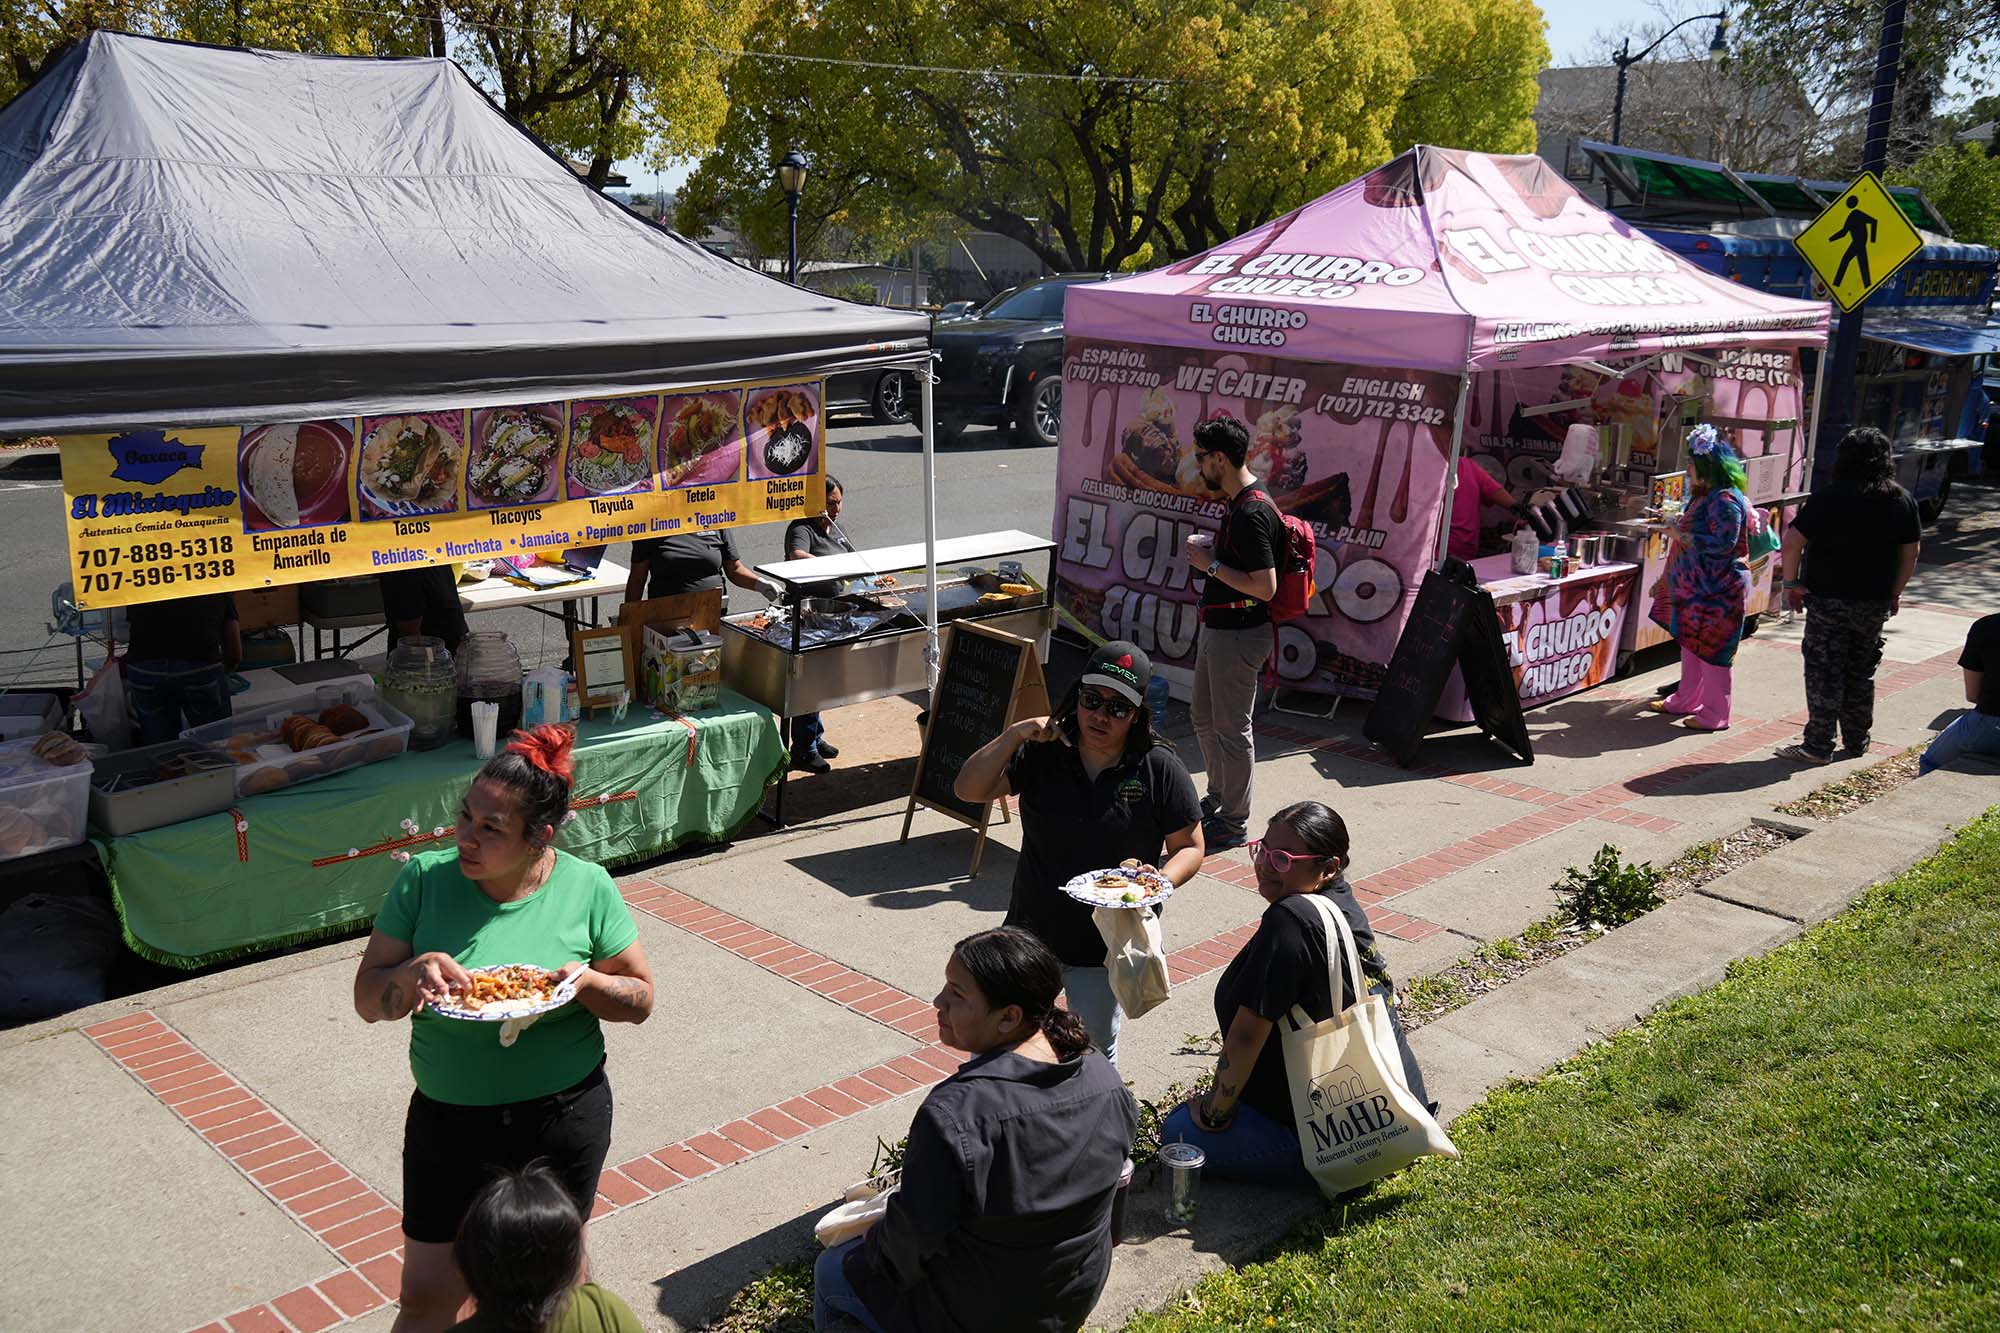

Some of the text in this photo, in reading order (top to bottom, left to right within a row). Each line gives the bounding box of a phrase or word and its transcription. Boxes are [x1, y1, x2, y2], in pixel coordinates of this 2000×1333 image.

[1443, 227, 1530, 273] EL
[1187, 254, 1426, 286] EL CHURRO
[1208, 277, 1358, 299] CHUECO
[1190, 304, 1308, 329] EL CHURRO
[1213, 325, 1286, 347] CHUECO
[1067, 363, 1100, 384] (707)
[1175, 365, 1307, 404] WE CATER
[1341, 377, 1426, 401] ENGLISH
[1316, 394, 1445, 425] (707) 712 3342
[125, 447, 189, 466] Oaxaca
[685, 487, 716, 504] Tetela
[766, 479, 804, 493] Chicken
[1081, 478, 1128, 502] RELLENOS
[1132, 489, 1196, 514] CHOCOLATE
[71, 485, 236, 520] El Mixtequito
[589, 497, 634, 516] Tlayuda
[766, 494, 805, 511] Nuggets
[79, 515, 230, 539] Autentica Comida Oaxaqueña
[393, 520, 431, 537] Tacos
[488, 507, 542, 526] Tlacoyos
[252, 528, 347, 553] Empanada de
[372, 509, 737, 567] Bebidas: Horchata Jamaica Pepino con Limon Tepache
[1061, 497, 1112, 569] EL
[1336, 526, 1387, 550] PLAIN
[78, 535, 234, 570] 707-889-5318
[273, 548, 331, 571] Amarillo
[80, 559, 235, 594] 707-596-1338
[1526, 607, 1617, 663] CHURRO
[1101, 662, 1139, 685] PEMEX
[1518, 653, 1594, 700] CHUECO
[1307, 1095, 1395, 1152] MoHB
[1315, 1124, 1409, 1166] Museum of History Benicia
